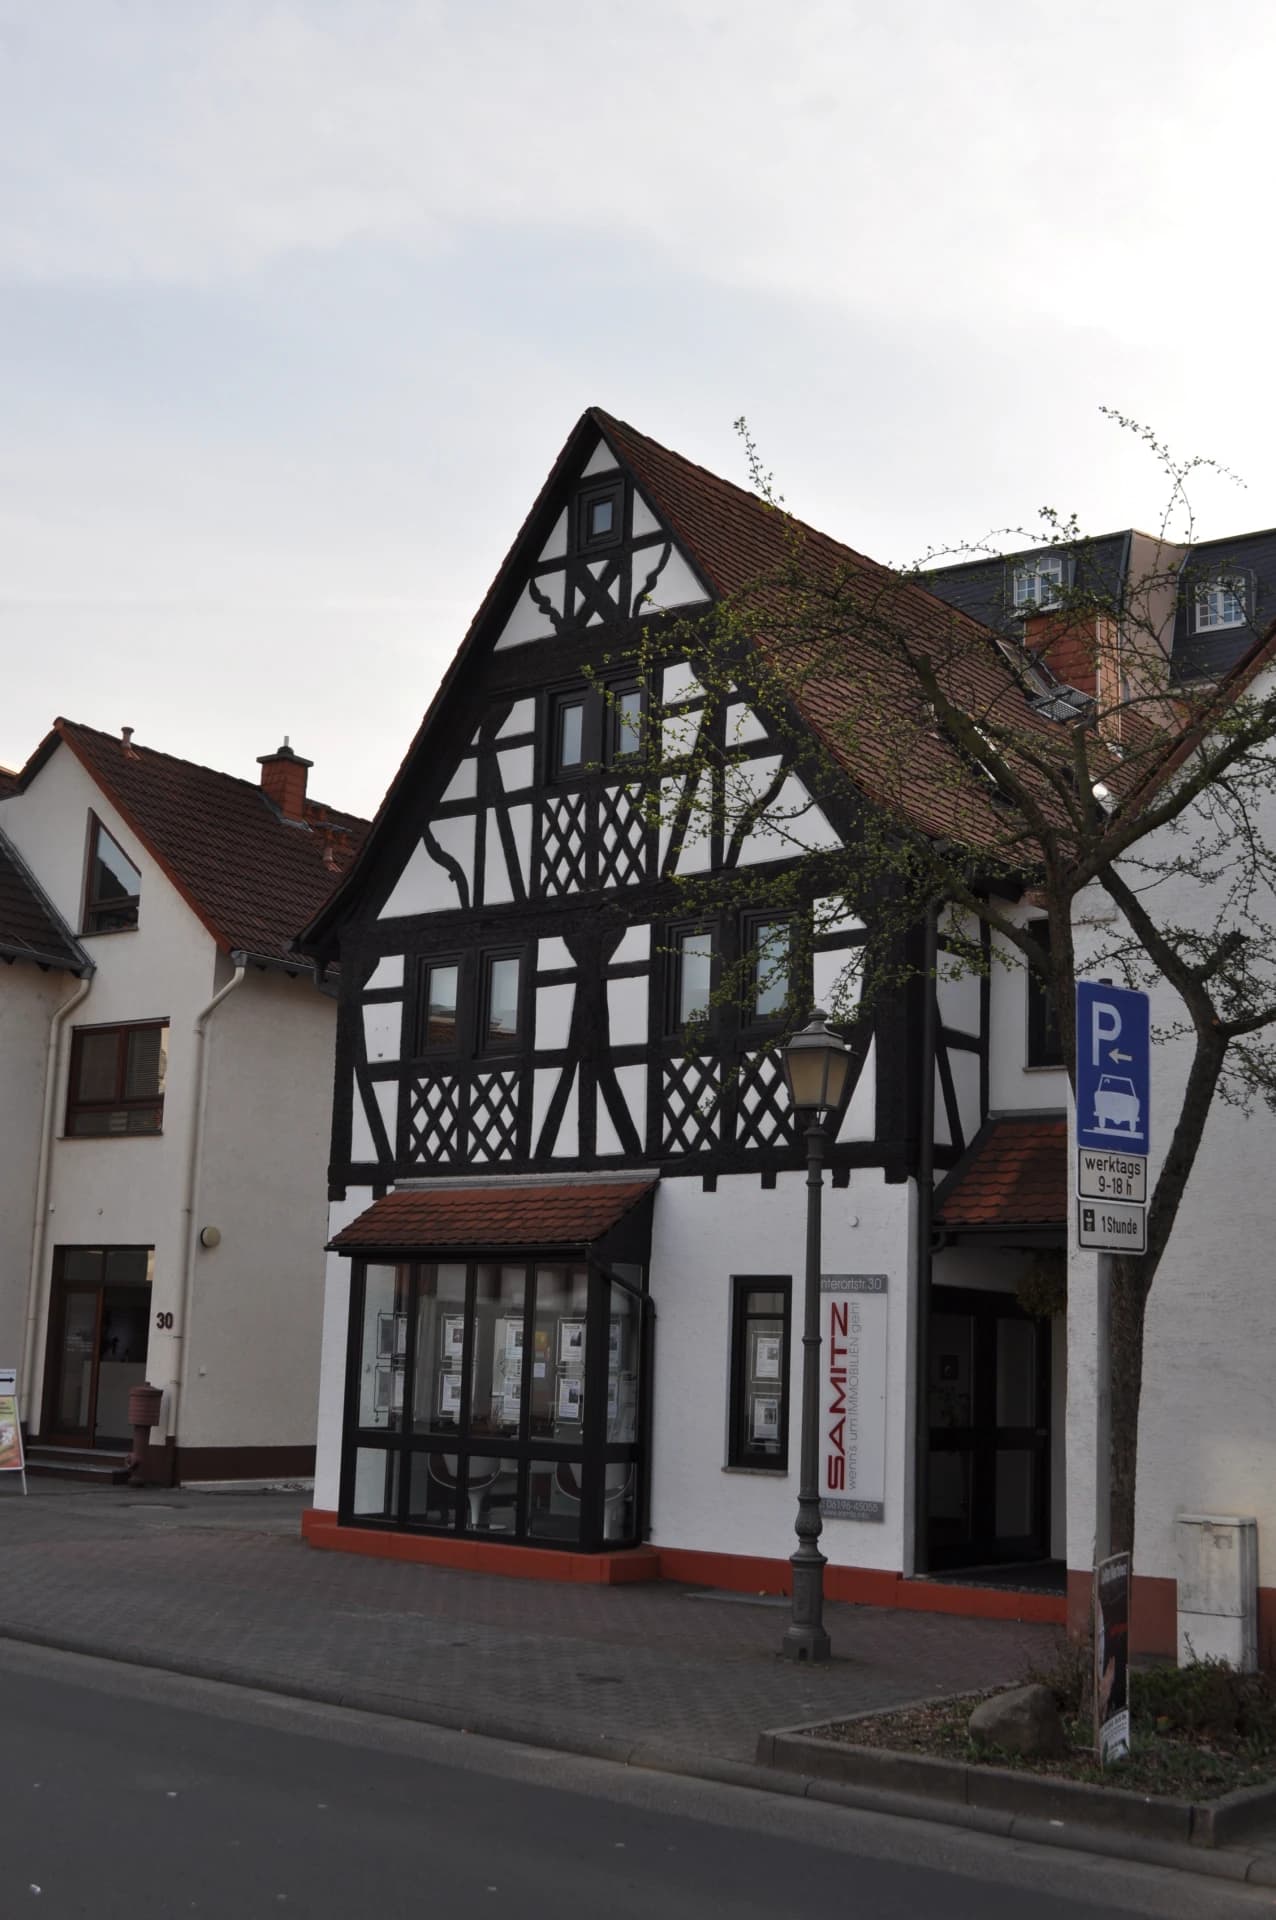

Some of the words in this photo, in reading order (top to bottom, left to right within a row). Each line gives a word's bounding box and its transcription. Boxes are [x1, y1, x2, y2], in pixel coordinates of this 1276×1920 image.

[1092, 1000, 1122, 1066] P
[1085, 1156, 1141, 1180] werktags
[1099, 1175, 1123, 1195] 9-18
[1126, 1179, 1132, 1196] h
[156, 1312, 173, 1329] 30
[827, 1302, 848, 1490] SAMITZ
